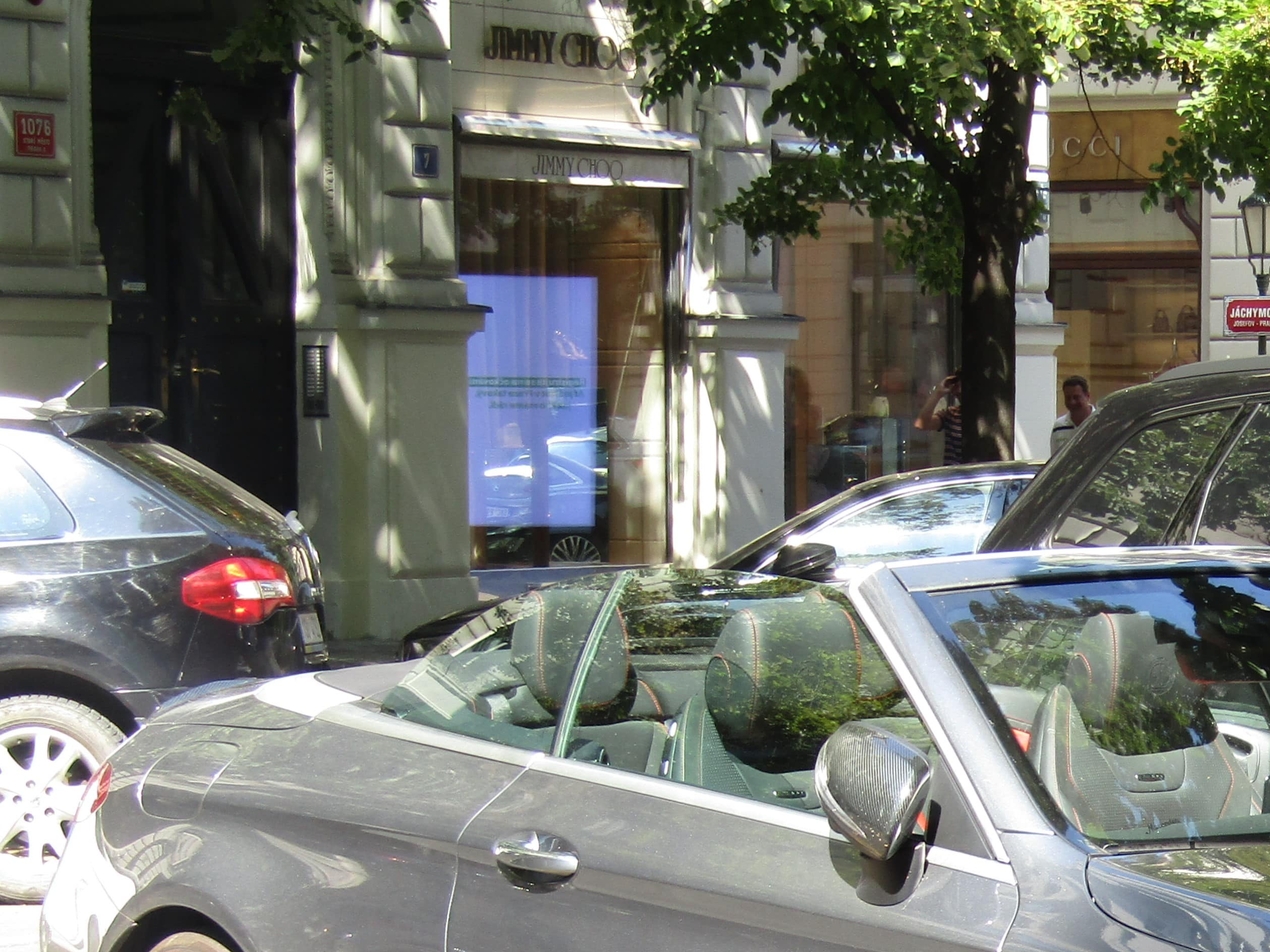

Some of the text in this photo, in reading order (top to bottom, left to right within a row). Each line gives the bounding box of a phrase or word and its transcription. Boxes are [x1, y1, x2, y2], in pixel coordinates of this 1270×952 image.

[484, 25, 640, 72] JIMMY CHOO
[21, 118, 51, 136] 1076
[1050, 136, 1121, 157] CCI
[423, 152, 430, 169] 7
[532, 154, 624, 180] JIMMY CHOO
